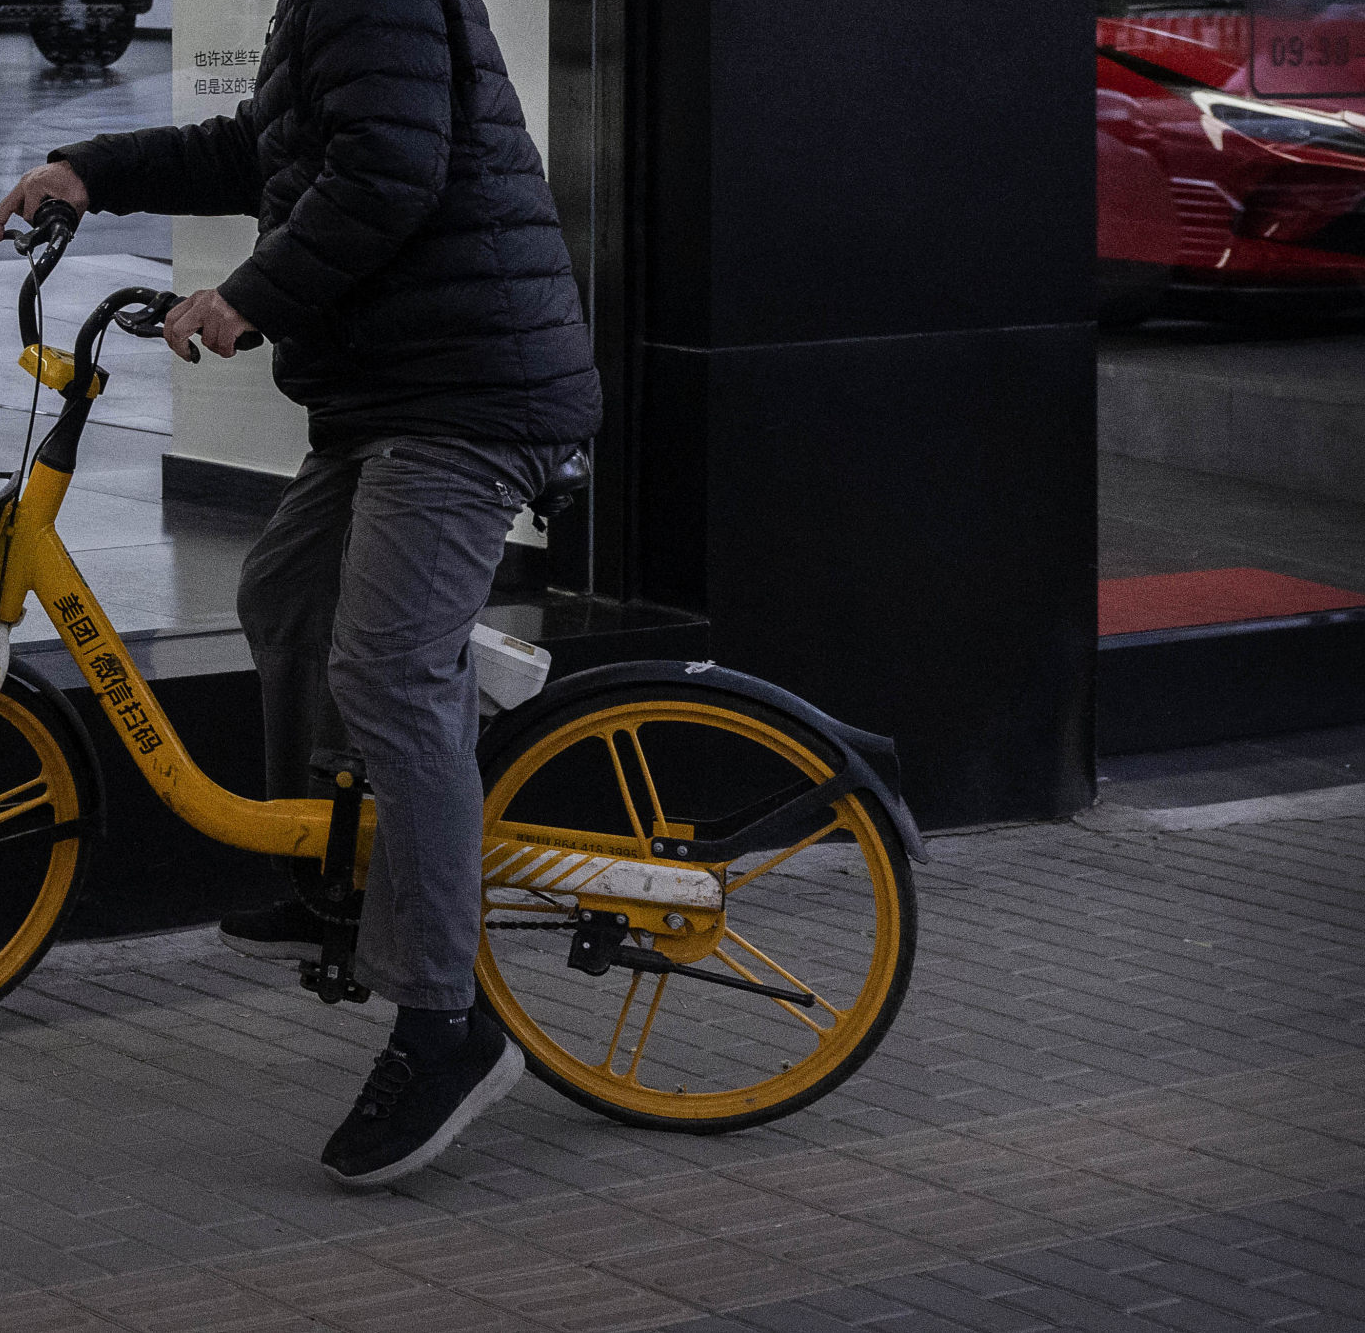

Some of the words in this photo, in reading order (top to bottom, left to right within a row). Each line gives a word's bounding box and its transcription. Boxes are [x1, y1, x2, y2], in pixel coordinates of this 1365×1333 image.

[53, 592, 98, 646] 美团
[89, 652, 163, 756] 微信扫码
[553, 838, 576, 850] 864
[579, 842, 603, 854] 418
